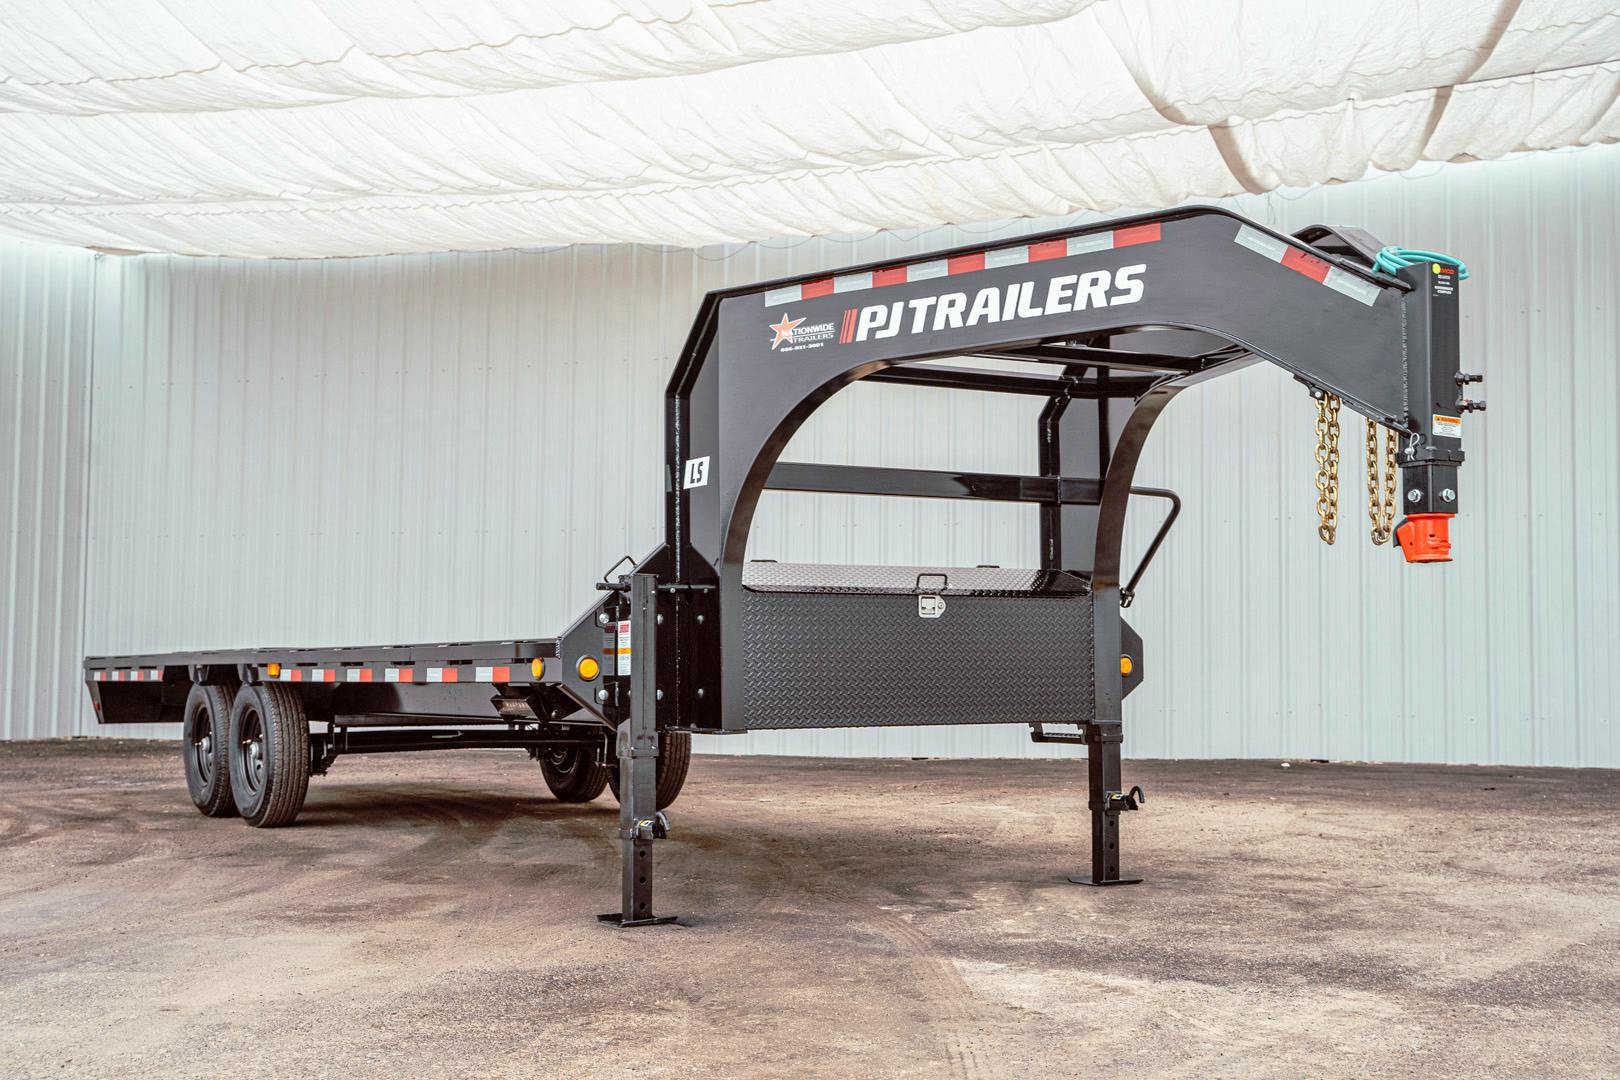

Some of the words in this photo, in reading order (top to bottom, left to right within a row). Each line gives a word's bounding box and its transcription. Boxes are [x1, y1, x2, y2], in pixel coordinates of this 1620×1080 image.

[909, 263, 1147, 334] TRAILERS
[781, 322, 835, 337] NATIONWIDE
[793, 333, 835, 343] TRAILERS
[690, 461, 704, 484] LS
